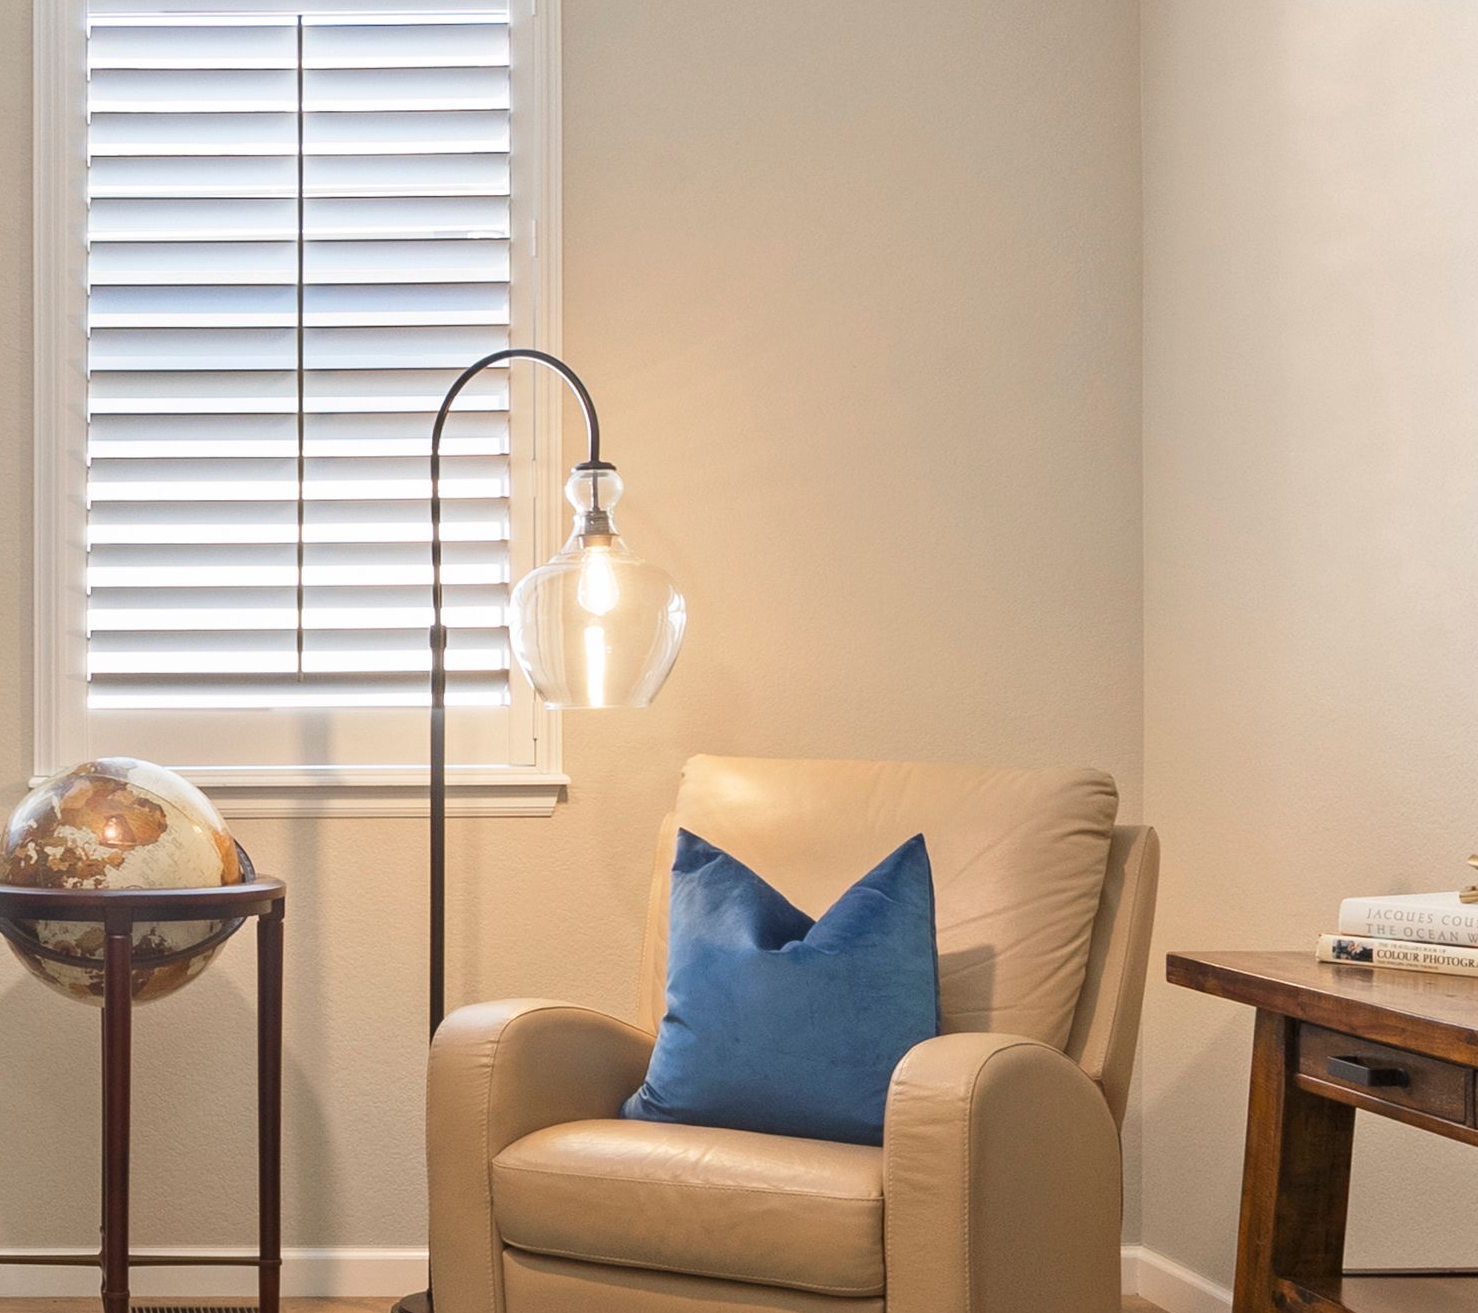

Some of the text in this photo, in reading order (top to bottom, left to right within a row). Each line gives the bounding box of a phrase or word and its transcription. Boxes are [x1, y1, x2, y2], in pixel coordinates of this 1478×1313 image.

[1367, 908, 1434, 924] JACQUES
[1366, 923, 1397, 937] THE
[1403, 926, 1459, 942] OCEAN
[1377, 948, 1420, 964] COLOUR
